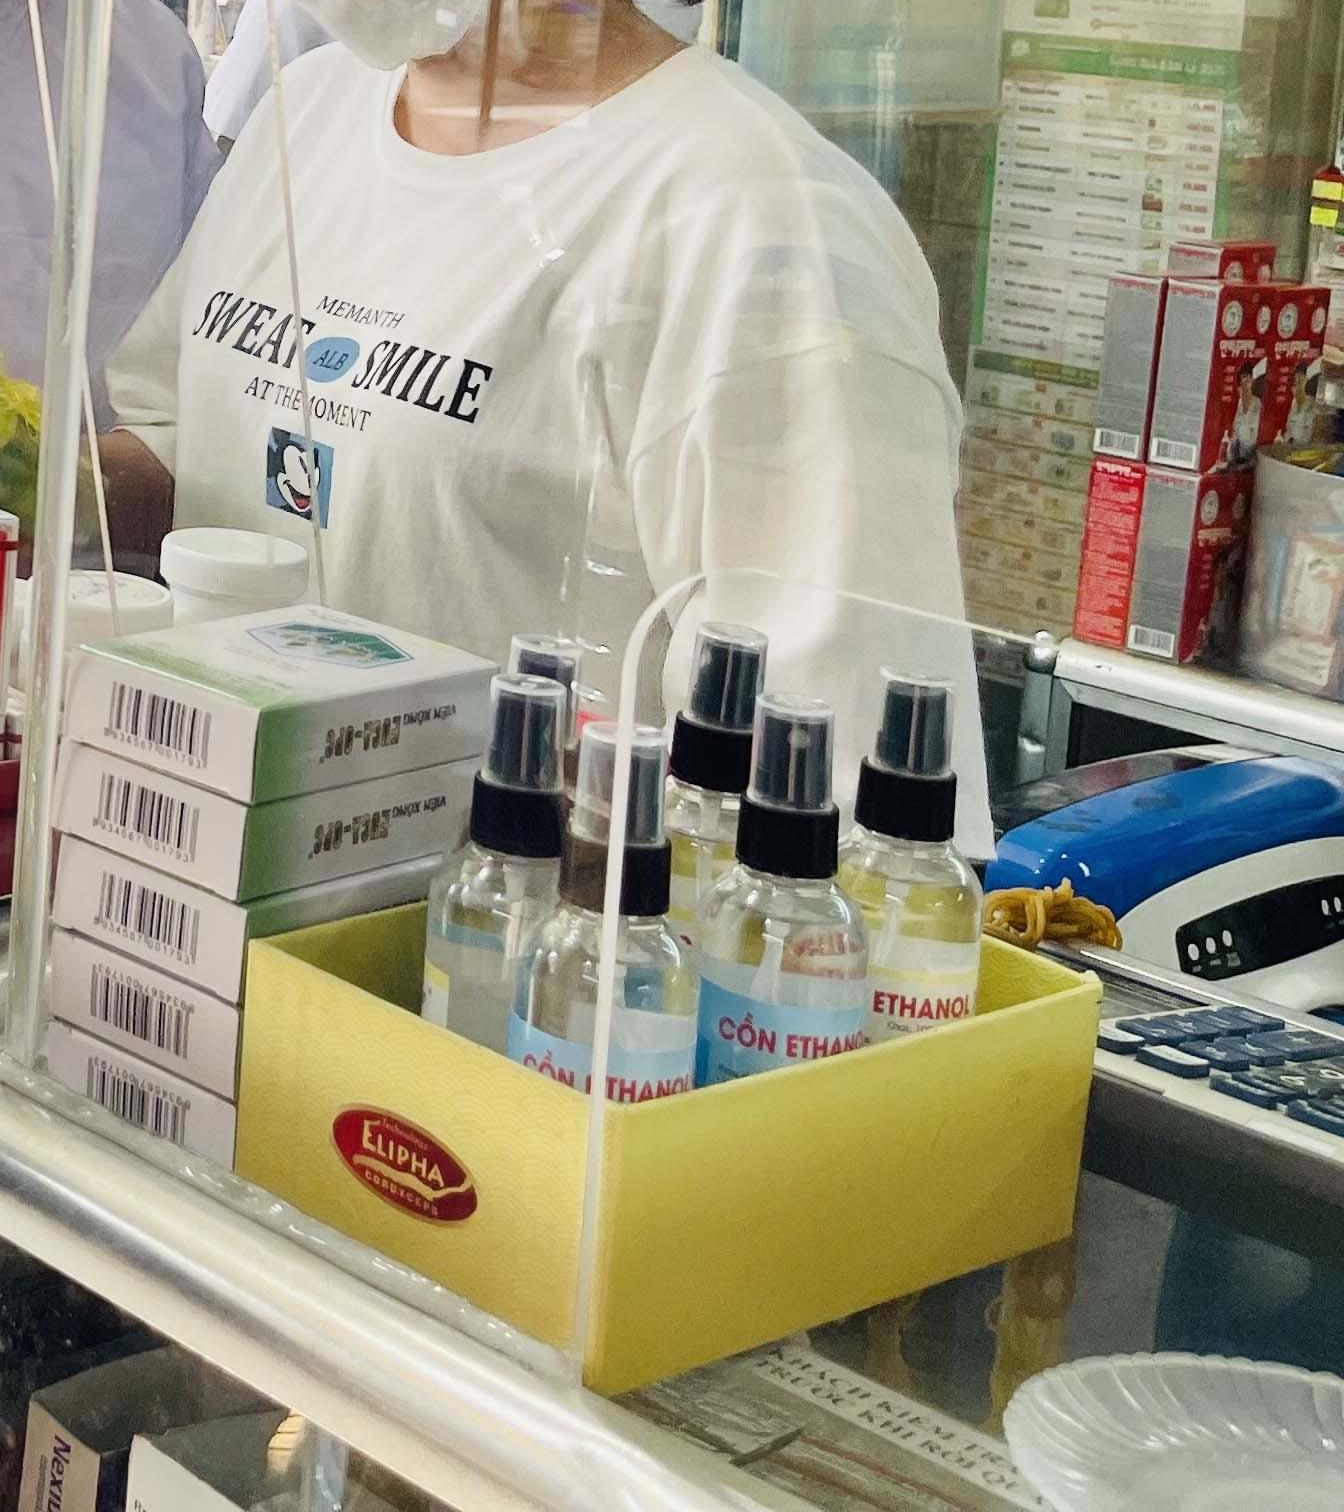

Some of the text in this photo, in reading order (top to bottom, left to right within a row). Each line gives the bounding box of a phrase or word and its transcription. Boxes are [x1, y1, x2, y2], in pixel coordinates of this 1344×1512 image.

[192, 290, 317, 370] SWEAT
[315, 295, 406, 330] MEMANTH
[243, 376, 275, 401] AT
[274, 383, 305, 412] THE
[350, 339, 494, 425] SMILE
[718, 1010, 777, 1055] CỒN
[361, 1119, 445, 1188] ELIPHA
